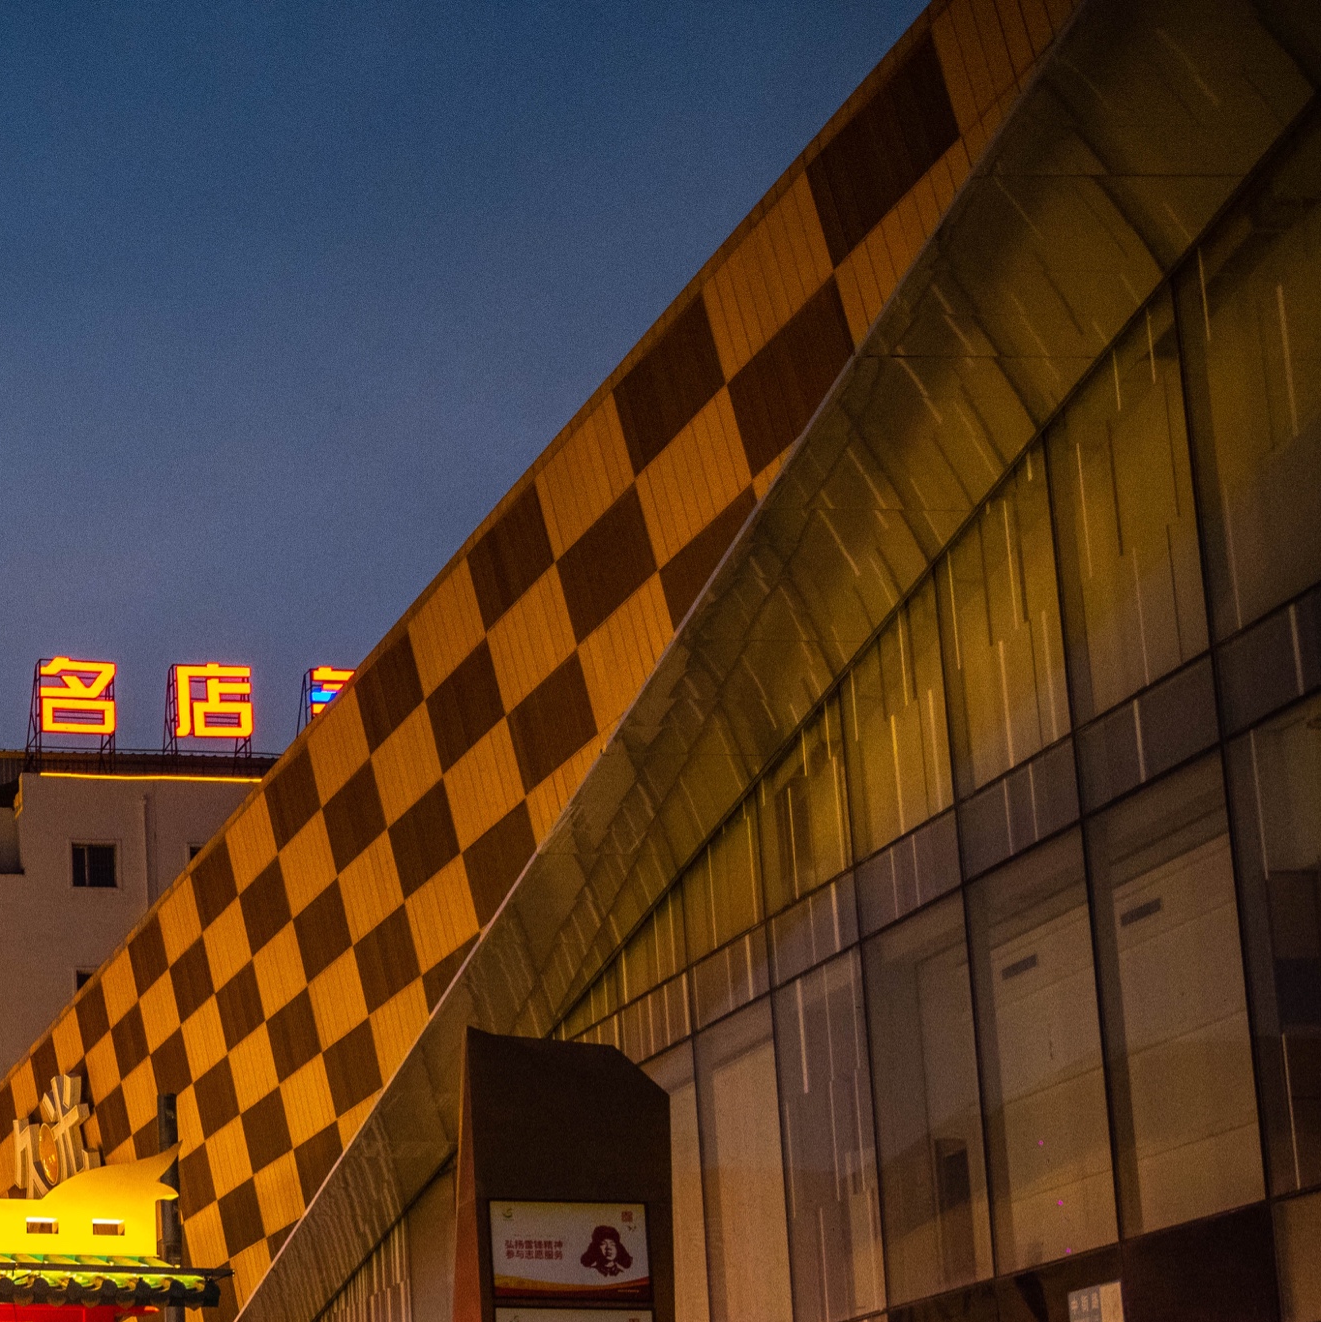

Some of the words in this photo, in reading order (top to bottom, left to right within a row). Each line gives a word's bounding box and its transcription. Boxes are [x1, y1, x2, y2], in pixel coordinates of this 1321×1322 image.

[504, 1239, 563, 1250] 弘扬雷锋精神
[506, 1250, 563, 1260] 参与志愿服务
